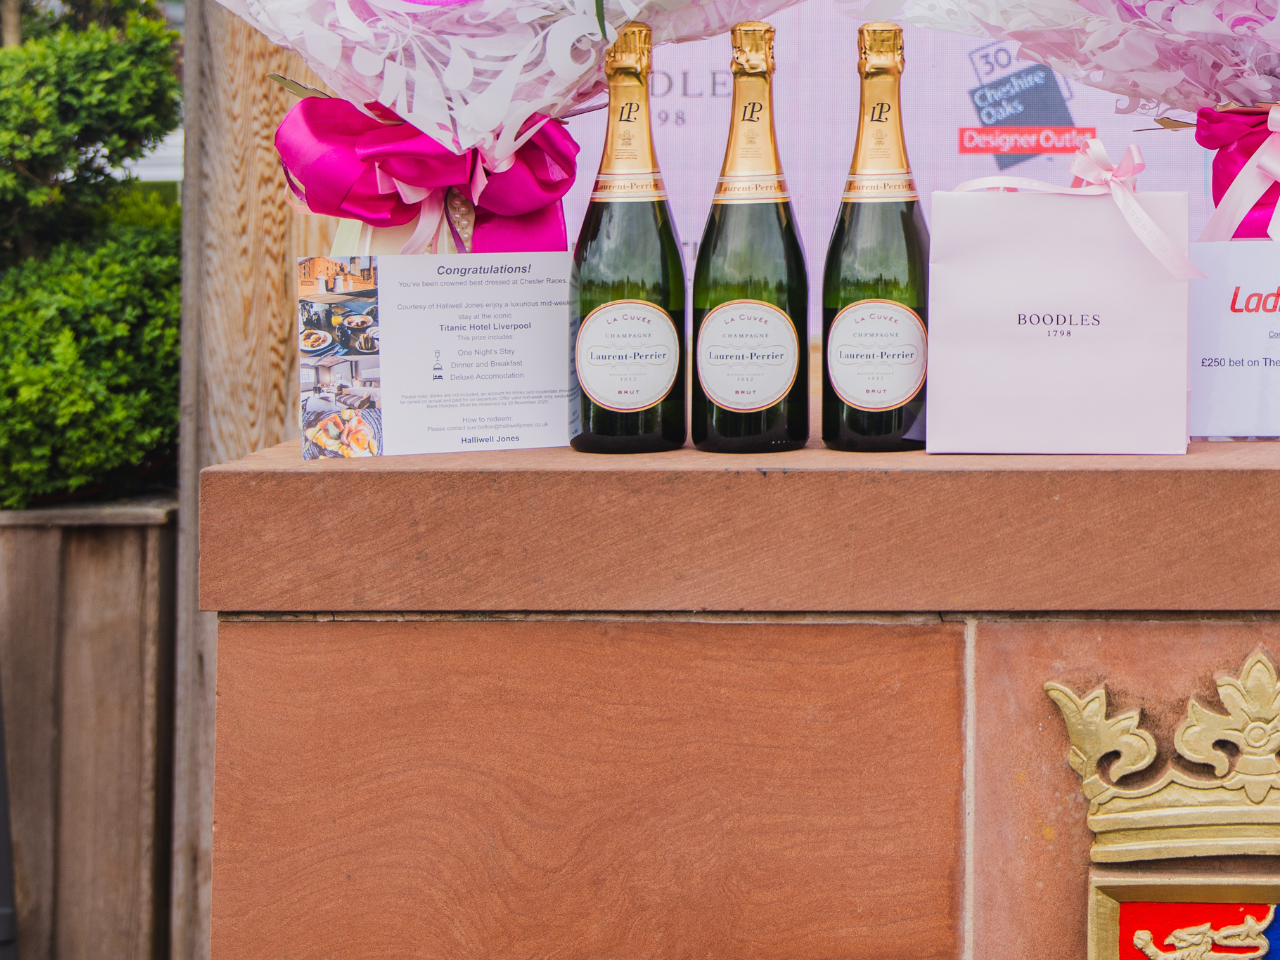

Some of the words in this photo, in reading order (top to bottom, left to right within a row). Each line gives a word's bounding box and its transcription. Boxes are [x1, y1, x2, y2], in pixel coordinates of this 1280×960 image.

[979, 46, 1012, 76] 30
[973, 68, 1047, 108] Cheshire
[979, 99, 1025, 126] Oaks
[657, 110, 686, 126] 98
[963, 130, 1038, 152] Designer
[1125, 202, 1168, 253] BOODLES
[436, 263, 532, 277] Congratulations!
[545, 277, 568, 285] Races.
[396, 303, 427, 311] Courtesy
[436, 302, 463, 310] Halliwell
[458, 313, 472, 321] stay
[481, 312, 492, 320] the
[606, 317, 618, 325] LA
[723, 317, 736, 325] LA
[1017, 313, 1101, 327] BOODLES
[438, 324, 467, 332] Titanic
[469, 323, 491, 331] Hotel
[493, 321, 532, 331] Liverpool
[471, 334, 487, 342] prize
[487, 333, 515, 341] includes:
[1046, 330, 1073, 338] 1798
[474, 348, 498, 357] Night's
[499, 348, 516, 356] Stay
[590, 351, 667, 360] Laurent-Perrier
[709, 351, 785, 360] Laurent-Perrier
[839, 350, 915, 359] Laurent-Perrier
[450, 361, 474, 369] Dinner
[475, 360, 489, 368] and
[490, 359, 523, 368] Breakfast
[1200, 357, 1226, 369] £250
[1228, 357, 1246, 368] bet
[1247, 359, 1260, 368] on
[449, 373, 475, 381] Deluxe
[476, 372, 525, 380] Accomodation
[462, 416, 478, 424] How
[486, 415, 514, 423] redeem:
[446, 424, 466, 432] contact
[461, 436, 495, 444] Halliwell
[496, 434, 520, 443] Jones
